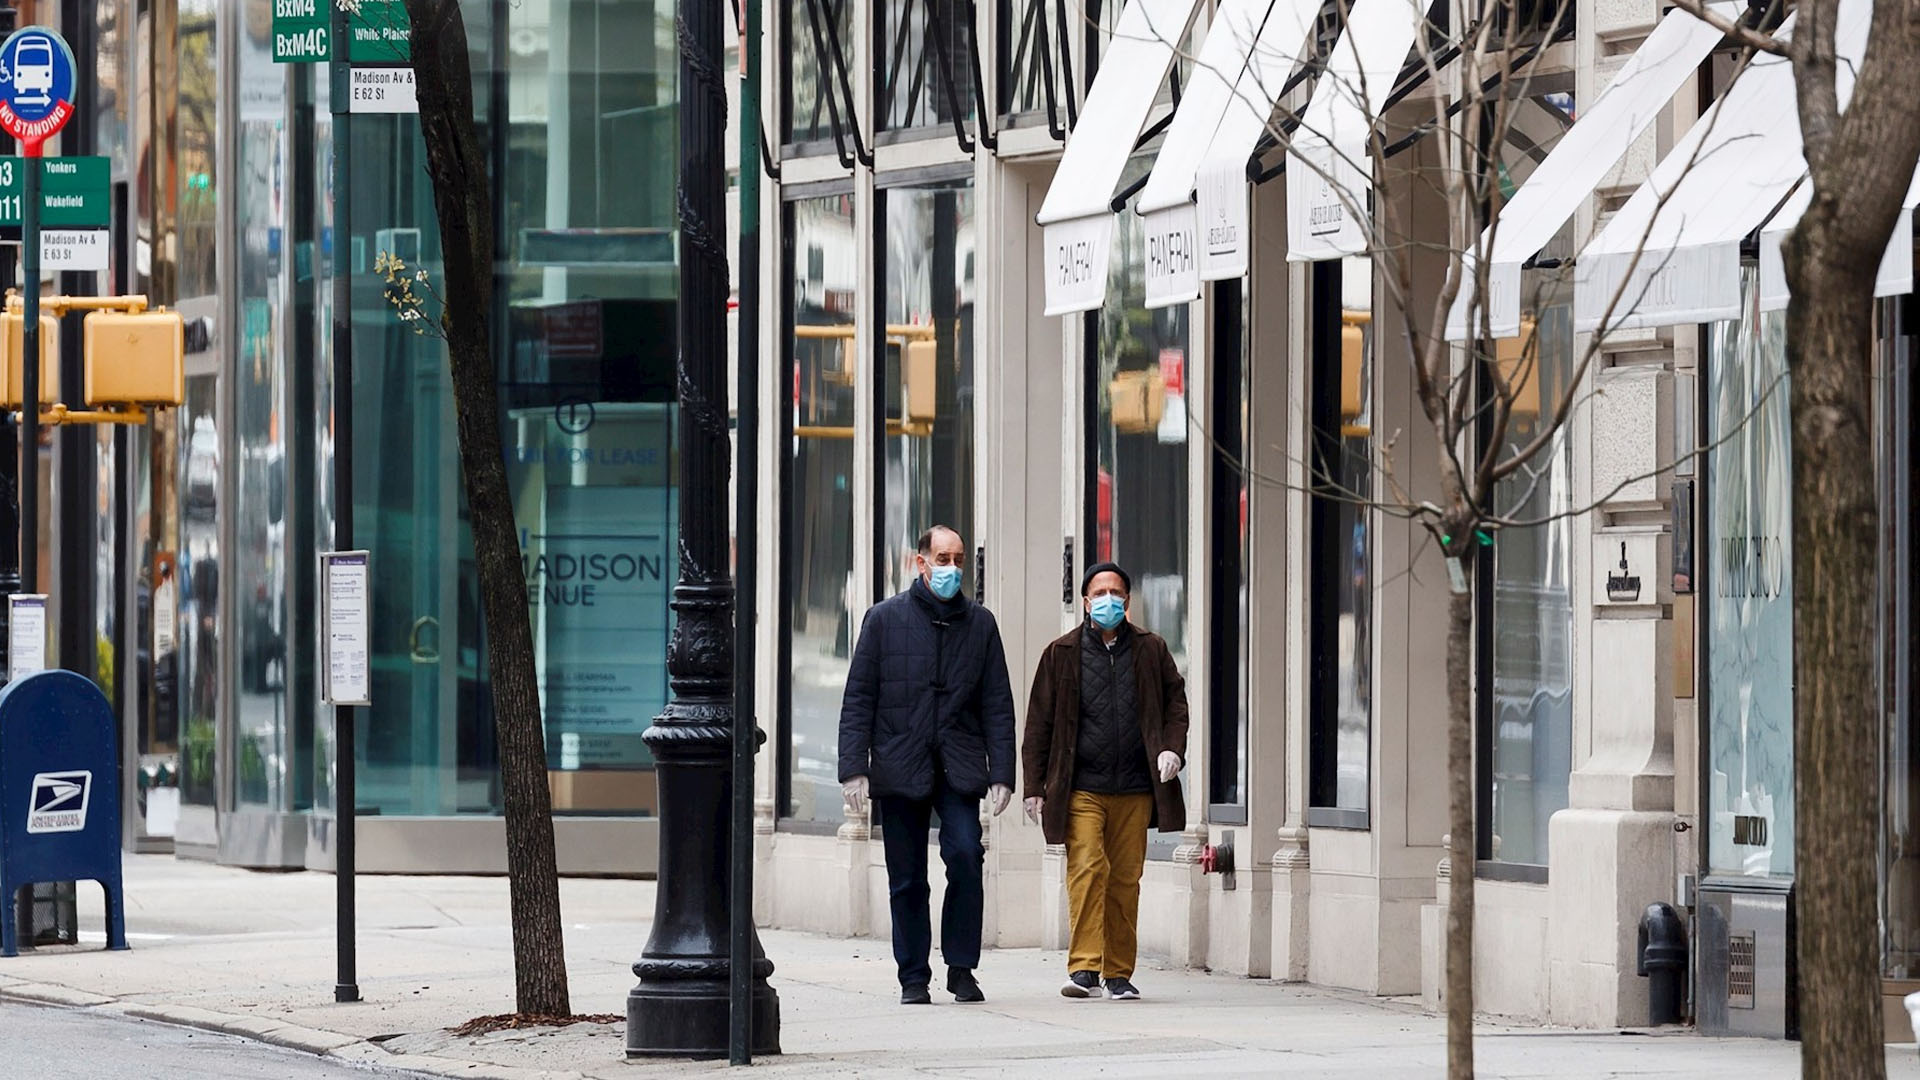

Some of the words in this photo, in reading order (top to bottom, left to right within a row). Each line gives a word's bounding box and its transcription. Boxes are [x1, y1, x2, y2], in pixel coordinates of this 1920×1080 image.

[355, 27, 380, 41] White
[276, 28, 327, 57] BxM4C
[354, 72, 390, 84] Madison
[392, 72, 403, 84] Av
[406, 72, 413, 84] &
[354, 88, 359, 100] E
[362, 88, 372, 100] 62
[375, 88, 384, 100] St
[0, 104, 14, 125] NO
[14, 106, 66, 137] STANDING
[45, 162, 77, 174] Yonkers
[45, 195, 83, 208] Wakefield
[44, 234, 76, 245] Madison
[79, 234, 88, 245] Av
[90, 234, 96, 245] &
[44, 249, 49, 260] E
[51, 249, 61, 260] 63
[63, 249, 72, 260] St
[1149, 229, 1194, 279] PANERAI
[1058, 239, 1096, 287] PANERAI
[527, 584, 596, 607] ENUE
